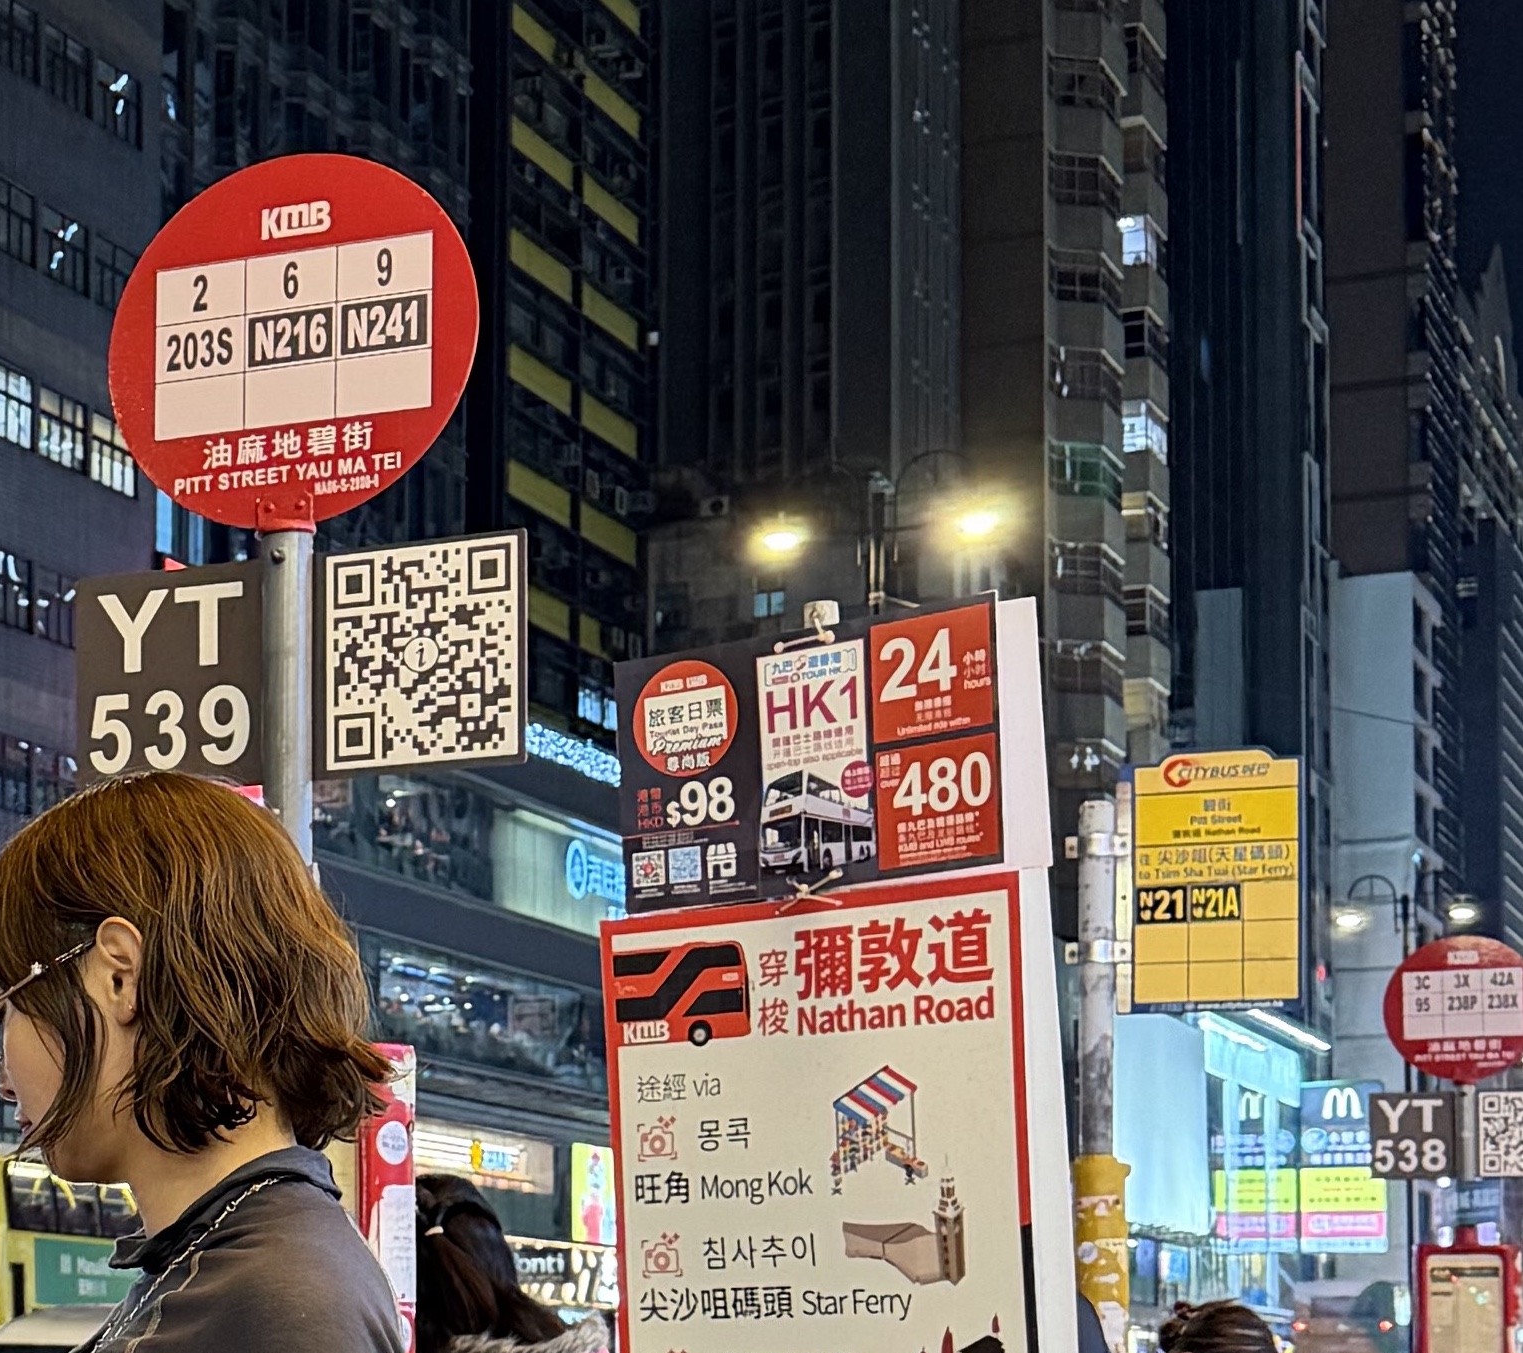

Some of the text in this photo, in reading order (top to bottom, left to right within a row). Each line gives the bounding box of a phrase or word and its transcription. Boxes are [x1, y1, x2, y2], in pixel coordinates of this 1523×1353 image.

[261, 200, 331, 240] KMB
[193, 248, 393, 312] 2 6 9
[167, 301, 420, 371] 203S N216 N241
[203, 421, 373, 470] 油麻地碧街
[174, 451, 402, 496] PITT STREET YAU MA TEI
[98, 581, 244, 674] YT
[802, 668, 827, 680] TOUR
[880, 628, 957, 702] 24
[964, 676, 991, 690] hours
[649, 698, 724, 727] 旅客日票
[766, 676, 858, 733] HK1
[88, 684, 251, 774] 539
[652, 734, 724, 756] Premium
[683, 724, 699, 737] Day
[702, 721, 724, 731] Pass
[893, 752, 991, 816] 480
[1178, 764, 1239, 779] CITYBUS
[667, 777, 735, 828] $98
[638, 817, 664, 829] HKD
[1139, 870, 1151, 880] to
[1183, 867, 1203, 877] Sha
[1139, 887, 1239, 922] N21 N21A
[794, 908, 994, 1000] 彌敦道
[1414, 971, 1515, 991] 3C 3X 42A
[797, 986, 995, 1036] Nathan Road
[1414, 994, 1519, 1012] 95 238P 238X
[623, 1020, 670, 1044] KMB
[636, 1073, 721, 1103] 途經 via
[697, 1117, 751, 1151] 몽콕
[1377, 1099, 1443, 1134] YT
[1374, 1140, 1448, 1173] 538
[635, 1168, 814, 1206] 旺角 Mong Kok
[701, 1232, 818, 1271] 침사추이
[639, 1285, 912, 1322] 尖沙咀碼頭 Star Ferry
